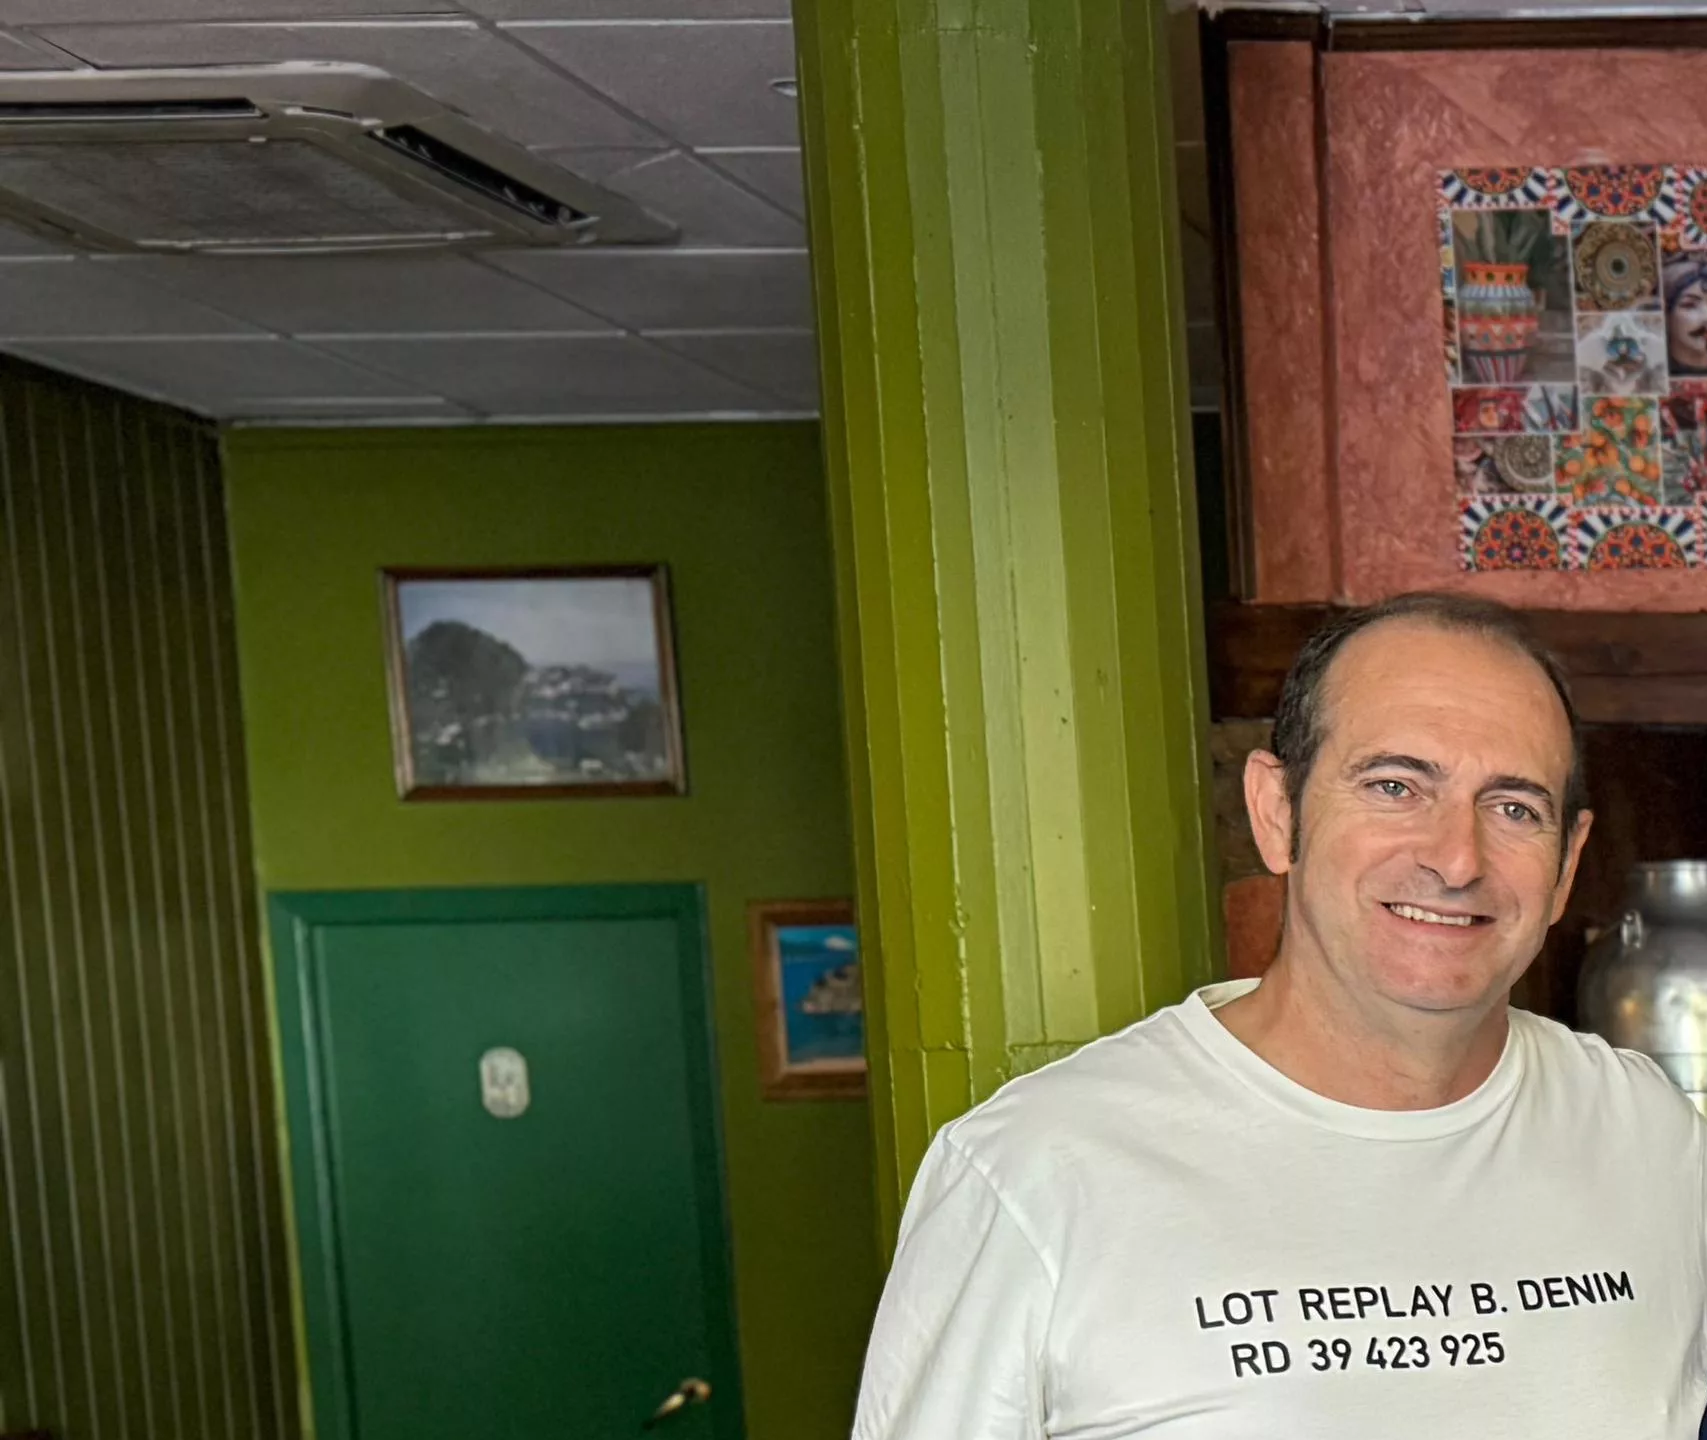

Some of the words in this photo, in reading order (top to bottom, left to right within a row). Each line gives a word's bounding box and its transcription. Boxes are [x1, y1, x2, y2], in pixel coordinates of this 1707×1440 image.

[1195, 1289, 1279, 1329] LOT
[1298, 1284, 1454, 1321] REPLAY
[1470, 1282, 1510, 1315] B.
[1517, 1270, 1635, 1311] DENIM
[1231, 1341, 1291, 1377] RD
[1307, 1338, 1352, 1372] 39
[1366, 1335, 1430, 1370] 423
[1440, 1331, 1505, 1367] 925
